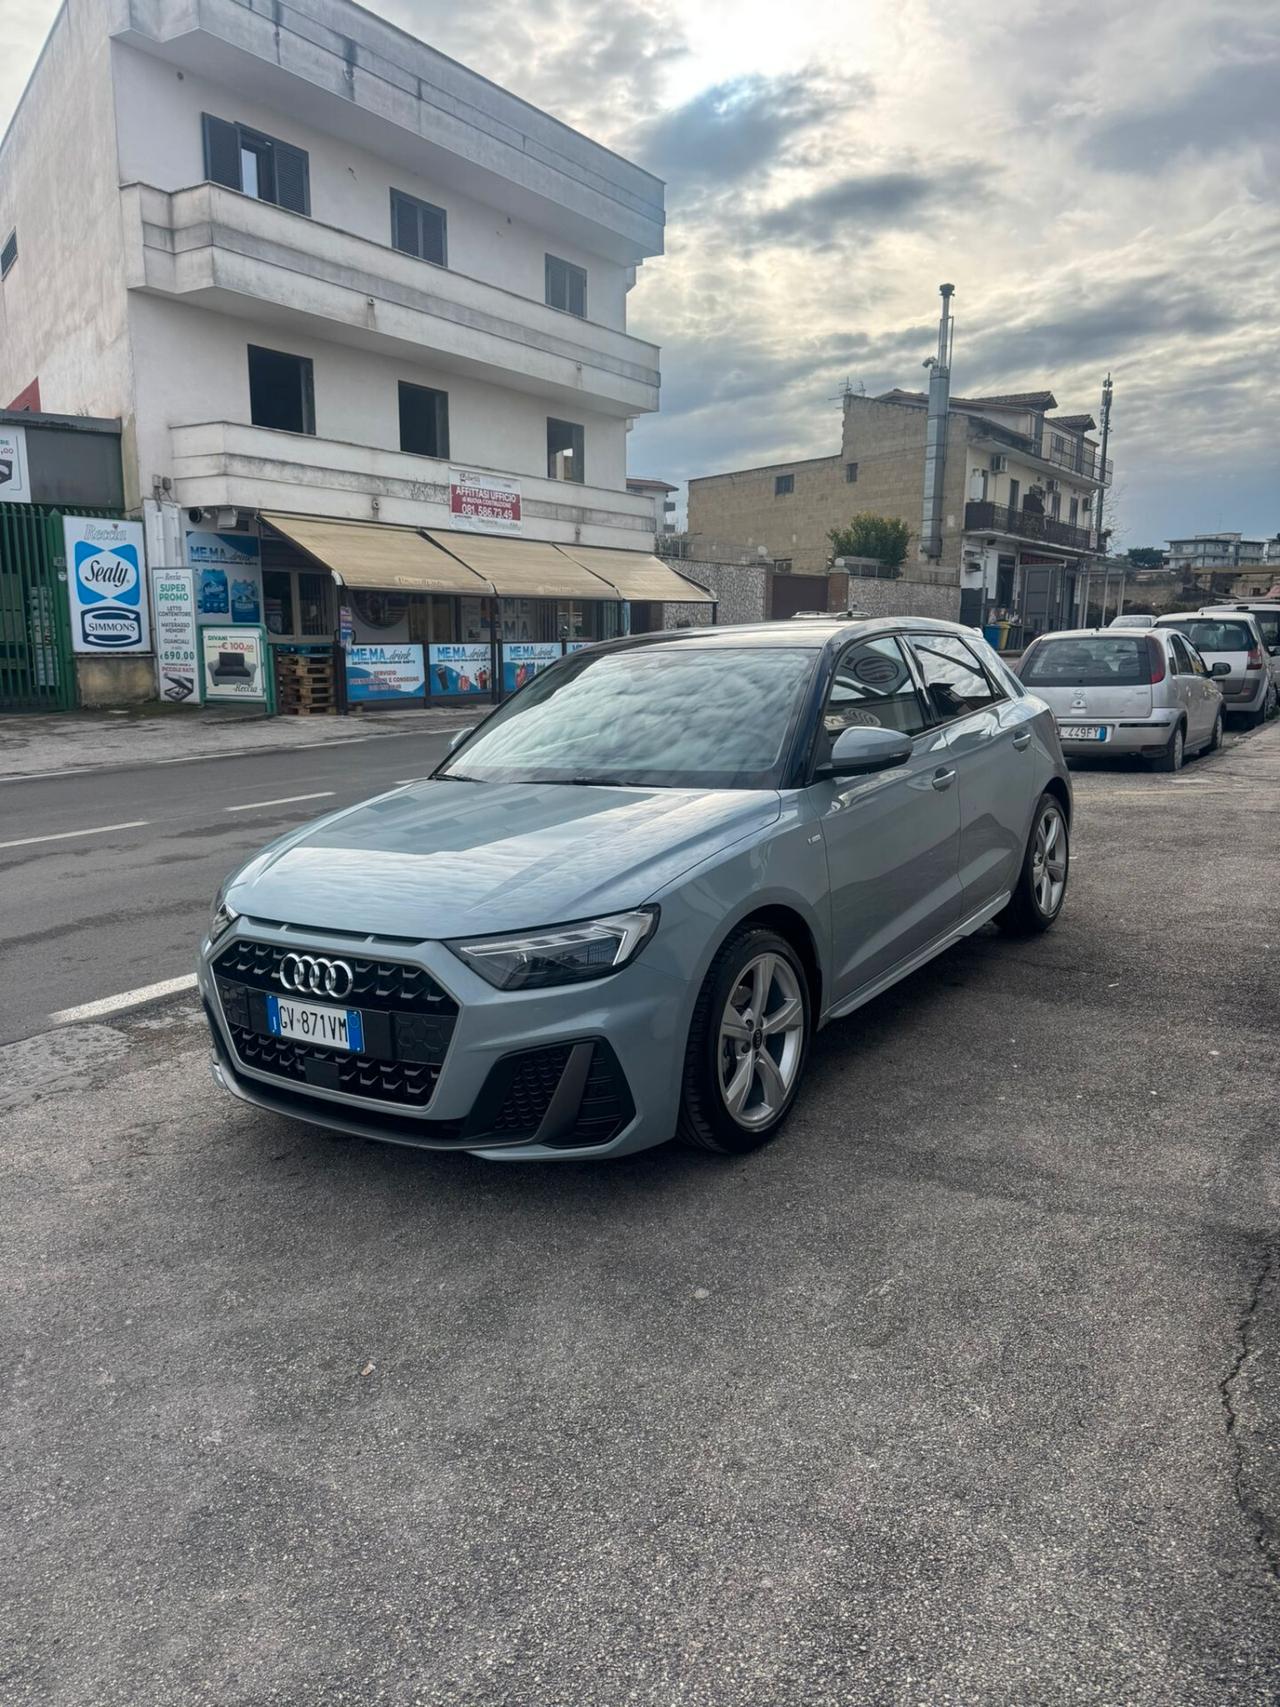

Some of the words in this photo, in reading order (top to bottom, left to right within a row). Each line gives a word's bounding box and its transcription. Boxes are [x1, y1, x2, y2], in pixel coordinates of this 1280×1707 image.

[456, 486, 489, 500] AFFITTASI
[490, 491, 516, 503] UFFICIO
[84, 560, 129, 588] Sealy
[160, 583, 186, 592] SUPER
[159, 593, 189, 601] PROMO
[88, 622, 136, 633] SIMMONS
[1068, 726, 1099, 738] 449FY
